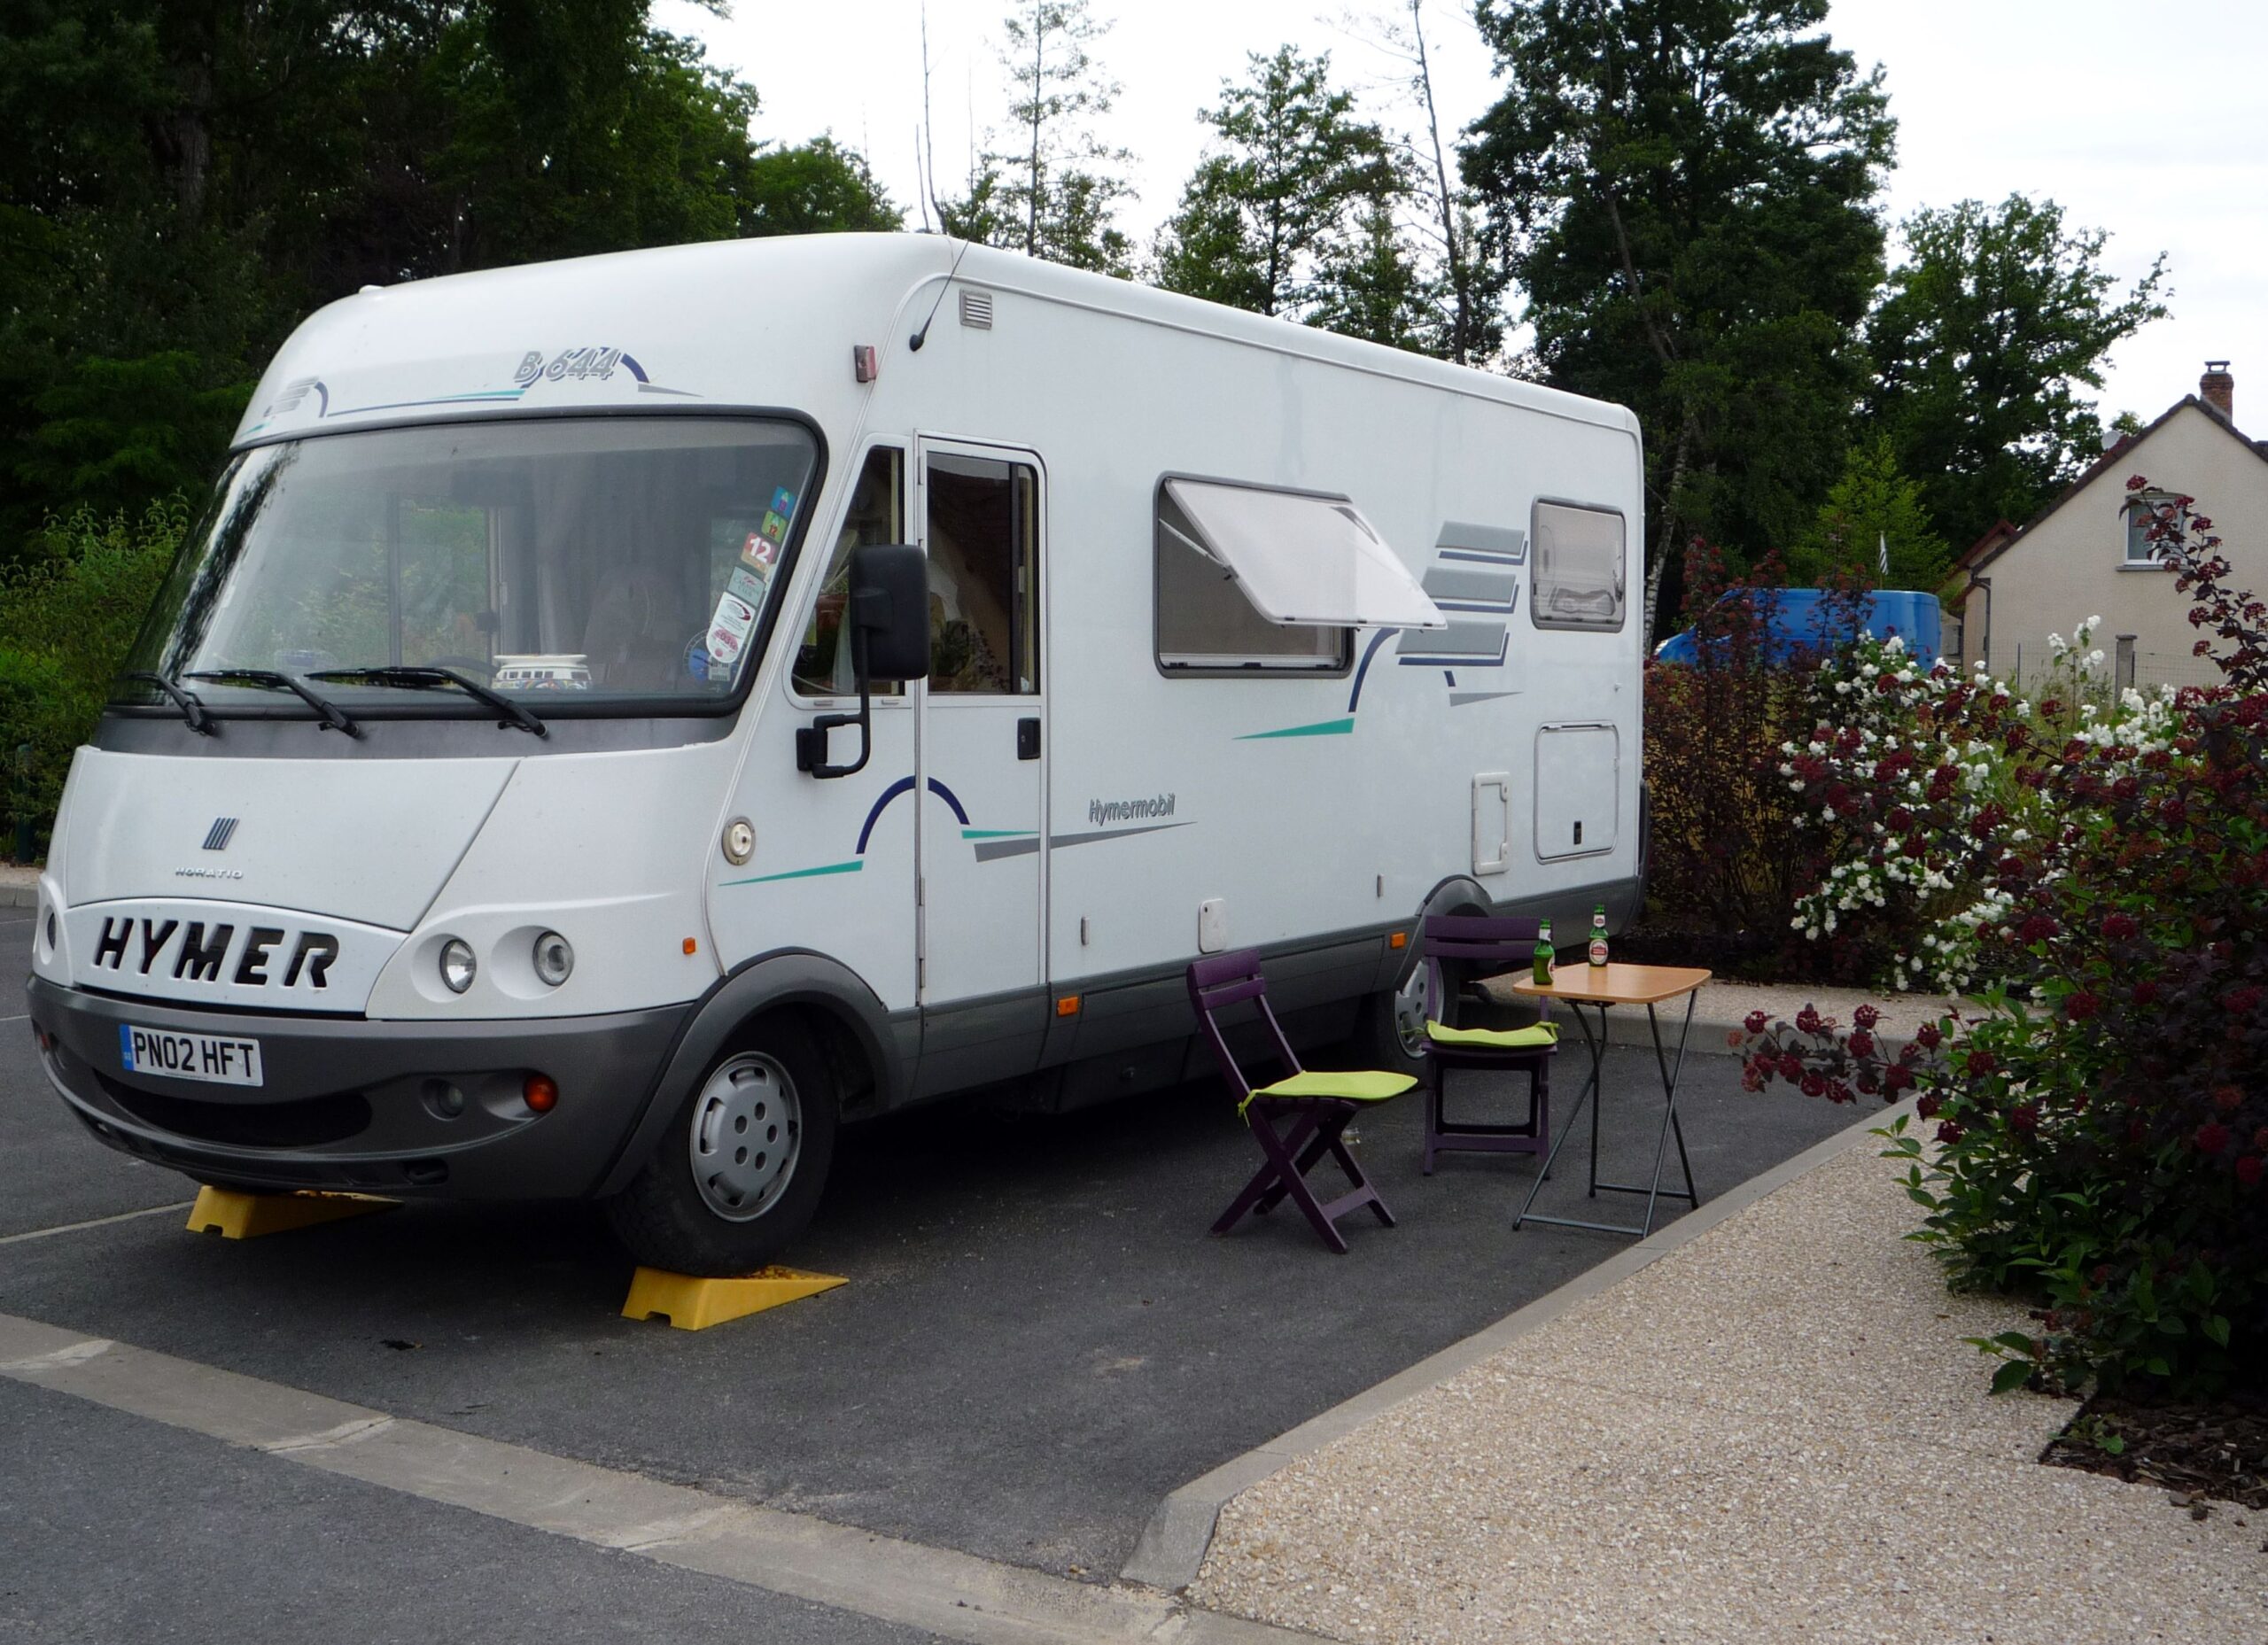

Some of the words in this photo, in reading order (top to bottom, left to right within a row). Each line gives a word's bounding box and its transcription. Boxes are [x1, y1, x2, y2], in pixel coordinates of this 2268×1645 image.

[513, 351, 543, 383] B
[545, 346, 621, 382] 644
[749, 536, 773, 564] 12
[1089, 793, 1176, 826] Hymermobil
[175, 866, 244, 880] HORATIO
[92, 916, 339, 989] HYMER
[134, 1031, 196, 1072] PN02
[200, 1039, 254, 1078] HFT
